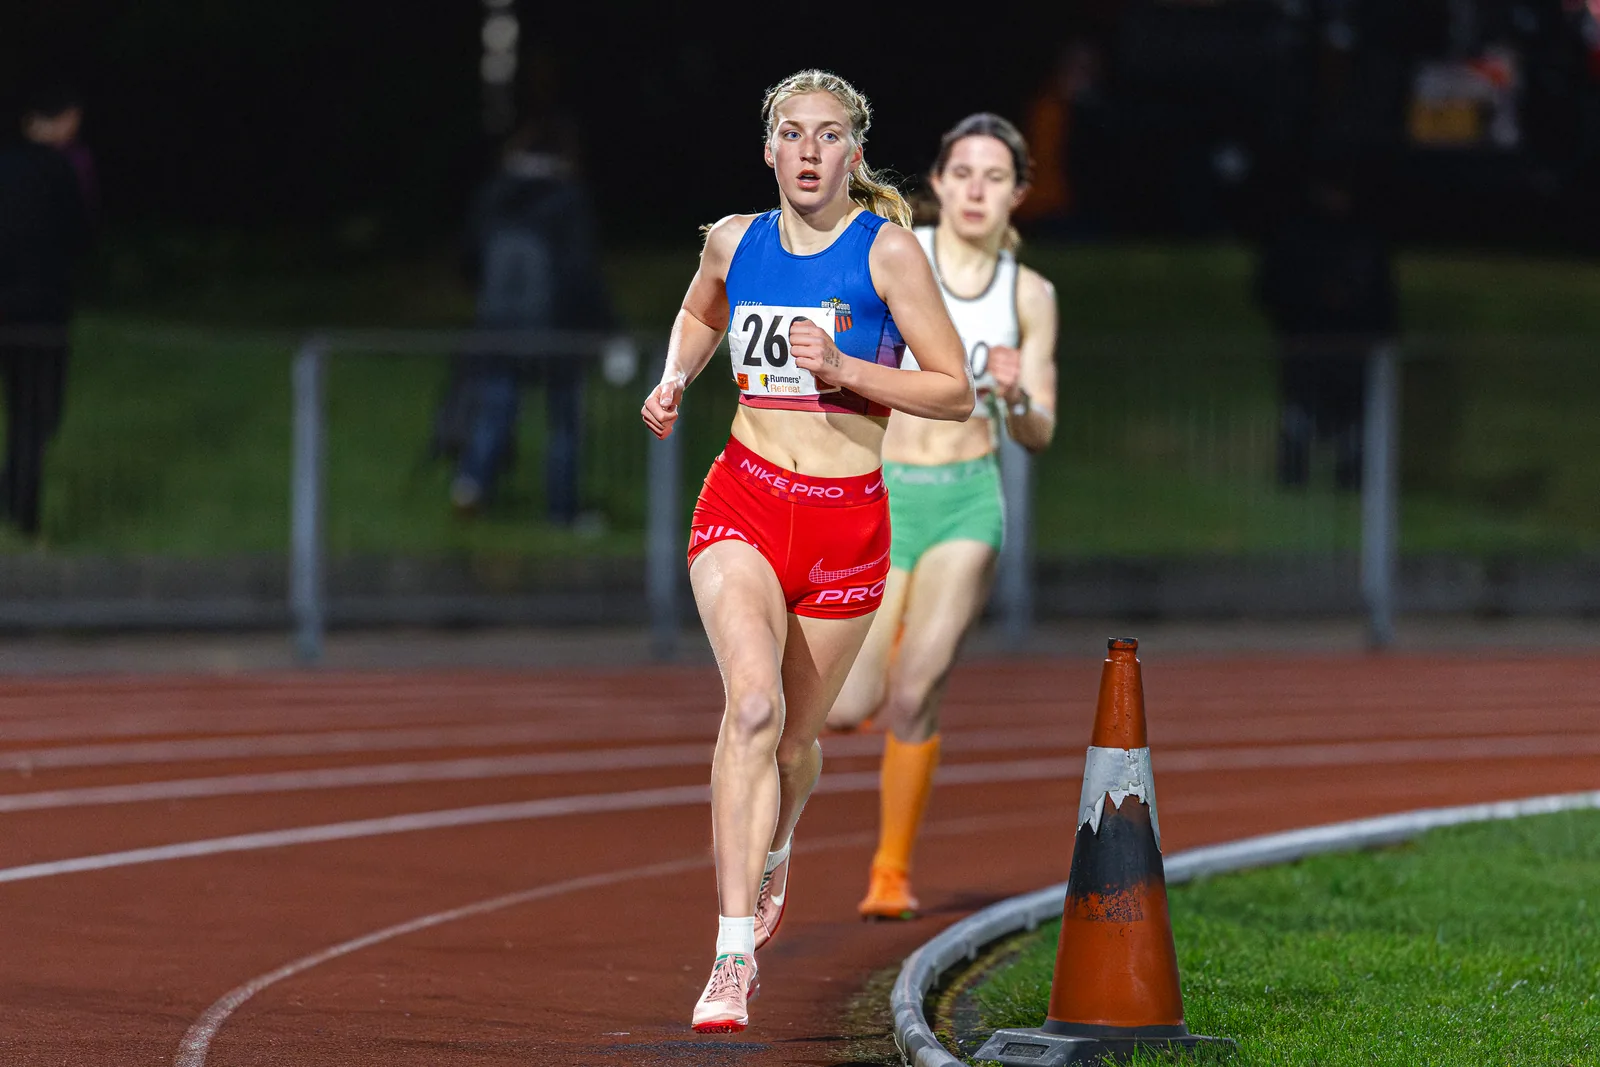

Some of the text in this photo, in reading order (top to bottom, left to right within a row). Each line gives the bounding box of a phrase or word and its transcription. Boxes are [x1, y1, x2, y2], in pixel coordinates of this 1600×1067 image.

[742, 313, 808, 368] 26
[770, 384, 800, 393] Retreat
[739, 459, 844, 499] NIKE PRO
[815, 579, 886, 604] PRO
